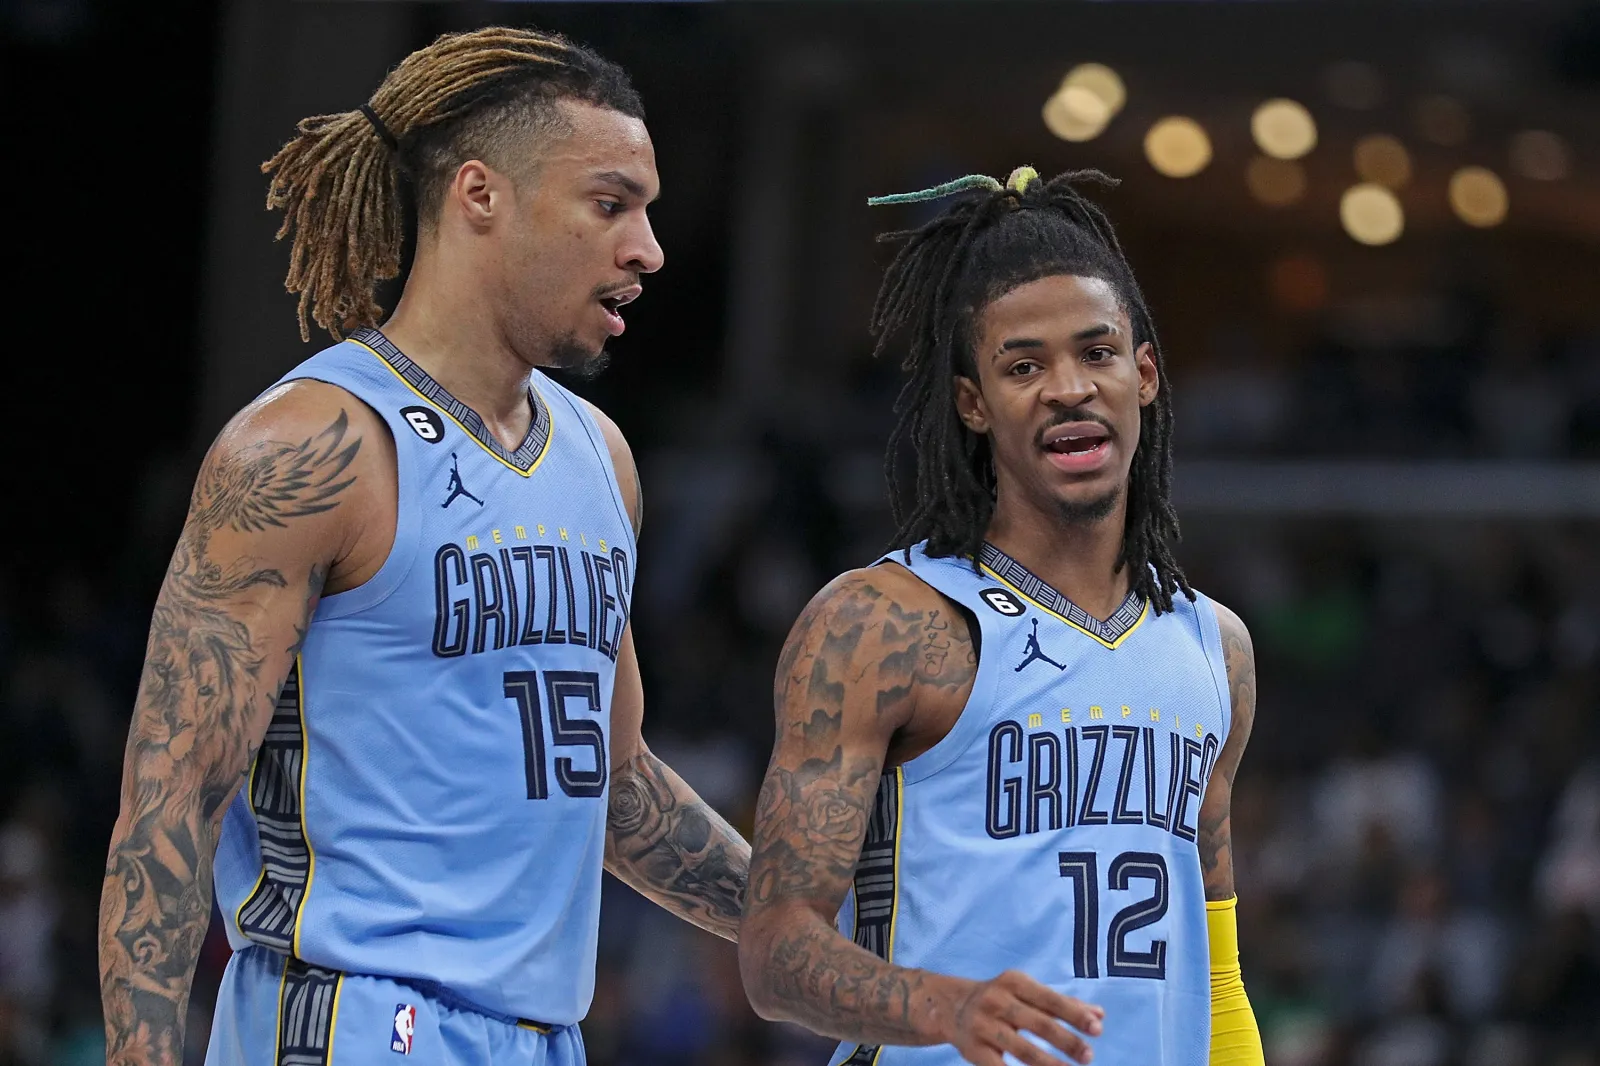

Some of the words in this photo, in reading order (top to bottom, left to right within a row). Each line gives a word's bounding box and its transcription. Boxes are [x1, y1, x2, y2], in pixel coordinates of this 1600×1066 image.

[405, 411, 438, 439] 6
[466, 524, 608, 553] MEMPHIS
[986, 593, 1019, 613] 6
[503, 670, 607, 800] 15
[1028, 705, 1204, 738] MEMPHIS
[1058, 851, 1169, 980] 12
